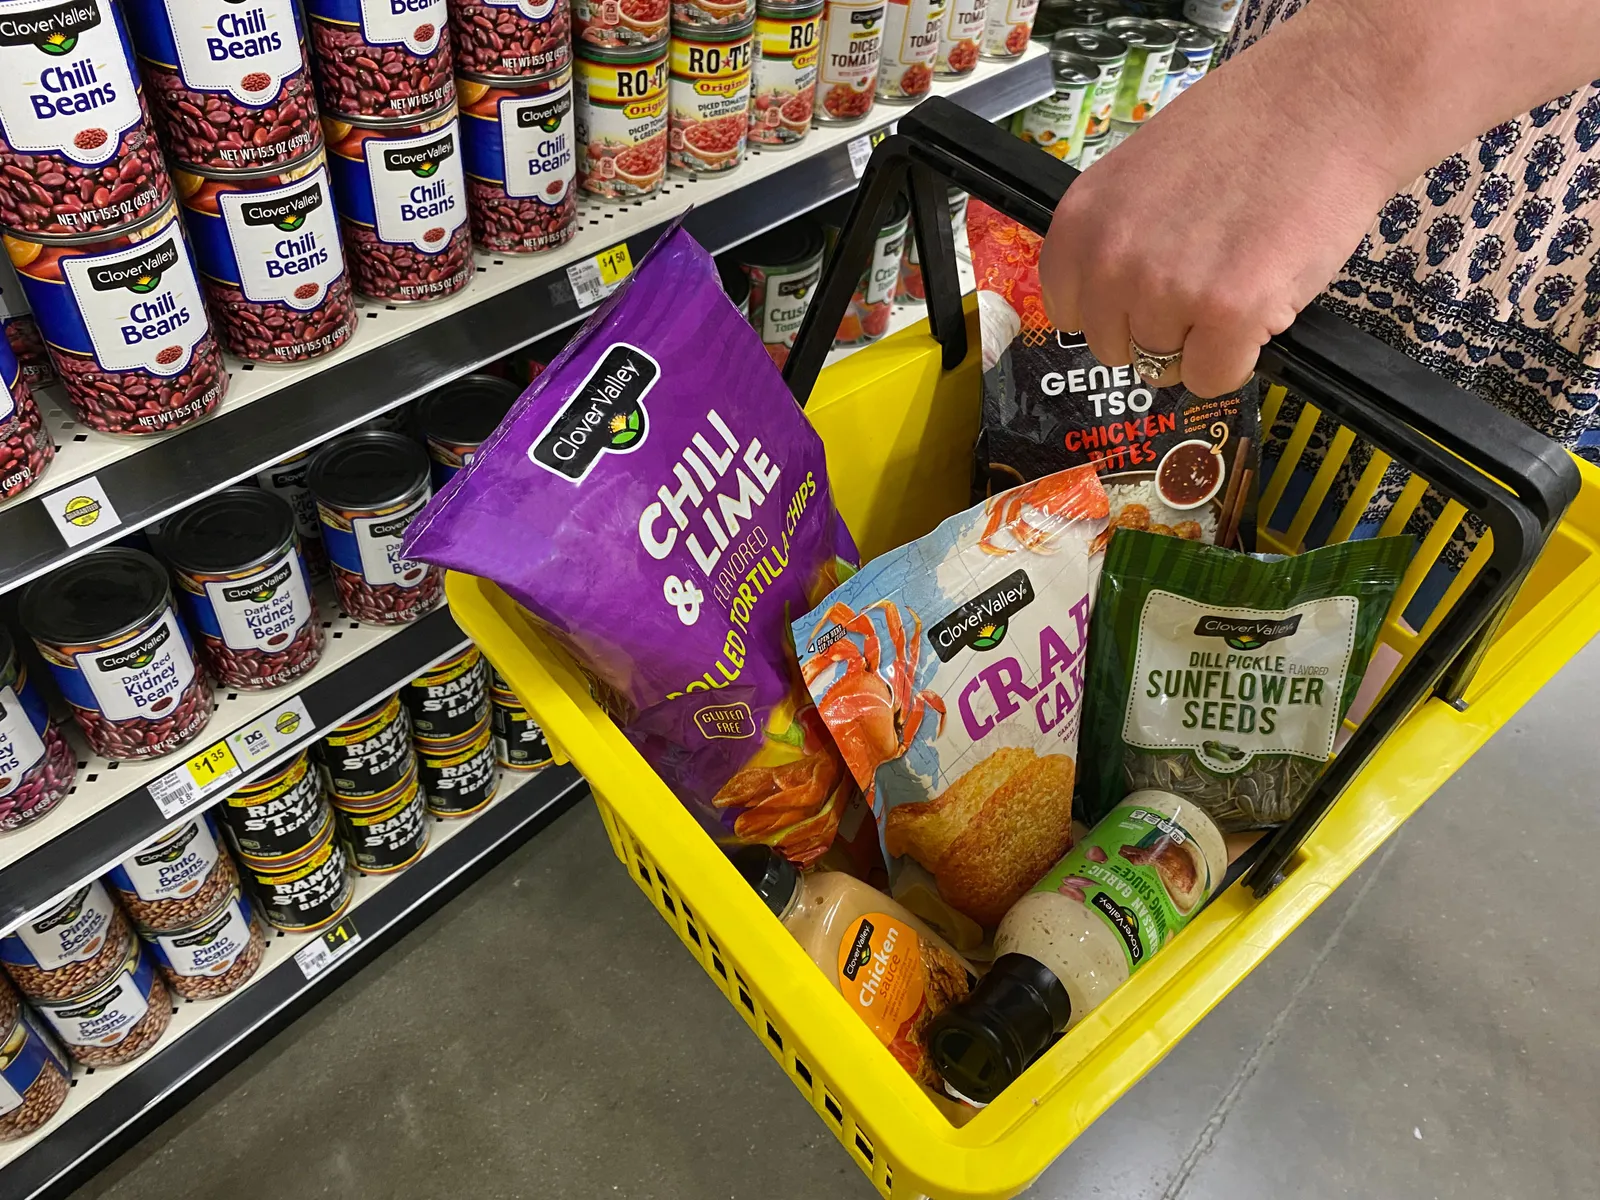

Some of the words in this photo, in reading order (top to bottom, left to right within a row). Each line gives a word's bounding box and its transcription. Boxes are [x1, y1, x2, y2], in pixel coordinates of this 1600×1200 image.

[0, 19, 55, 37] Clover
[54, 6, 92, 28] Valley
[390, 0, 440, 15] Bean
[217, 8, 267, 38] Chili
[789, 23, 814, 50] RO
[206, 31, 282, 61] Beans
[689, 47, 721, 75] RO
[40, 58, 97, 94] Chili
[617, 70, 648, 97] RO
[30, 82, 116, 120] Beans
[522, 107, 553, 122] Clover
[220, 148, 238, 161] NET
[239, 148, 256, 161] WT
[256, 145, 275, 159] 15.5
[275, 140, 288, 154] OZ
[390, 152, 427, 165] Clover
[427, 142, 451, 159] Valley
[537, 133, 565, 158] Chili
[528, 148, 571, 175] Beans
[249, 203, 290, 219] Clover
[289, 191, 318, 212] Valley
[410, 179, 446, 204] Chili
[57, 212, 78, 226] NET
[79, 210, 98, 224] WT
[99, 205, 120, 221] 15.5
[120, 199, 134, 214] OZ
[400, 195, 455, 221] Beans
[275, 232, 317, 259] Chili
[97, 264, 142, 283] Clover
[141, 248, 173, 271] Valley
[266, 248, 328, 279] Beans
[400, 286, 415, 296] NET
[416, 284, 428, 294] WT
[429, 281, 443, 293] 15.5
[443, 277, 453, 289] OZ
[130, 291, 176, 323] Chili
[121, 307, 190, 345] Beans
[274, 346, 290, 356] NET
[291, 344, 305, 355] WT
[306, 340, 321, 352] 15.5
[321, 335, 333, 347] OZ
[139, 416, 158, 427] NET
[158, 411, 174, 424] WT
[174, 405, 191, 420] 15.5
[191, 399, 202, 412] OZ
[552, 403, 605, 463] Clover
[597, 358, 641, 406] Valley
[1088, 388, 1153, 418] TSO
[1183, 405, 1200, 416] with
[1202, 402, 1218, 410] rice
[1190, 409, 1222, 423] General
[1223, 408, 1238, 416] Tso
[1065, 412, 1176, 452] CHICKEN
[1088, 440, 1157, 472] BITES
[639, 409, 740, 560] CHILI
[374, 519, 405, 534] Clover
[663, 575, 703, 626] &
[685, 437, 781, 577] LIME
[713, 525, 769, 610] FLAVORED
[229, 584, 264, 598] Clover
[263, 568, 288, 587] Valley
[665, 629, 746, 700] OLLED
[729, 531, 790, 634] TORTILLA
[785, 471, 816, 537] CHIPS
[244, 604, 270, 617] Dark
[272, 590, 290, 607] Red
[246, 599, 294, 629] Kidney
[938, 609, 984, 649] Clover
[980, 583, 1023, 618] Valley
[253, 614, 296, 640] Beans
[1205, 620, 1254, 633] Clover
[1256, 622, 1291, 636] Valley
[102, 648, 141, 668] Clover
[140, 630, 168, 652] Valley
[1189, 651, 1223, 669] DILL
[1224, 653, 1287, 673] PICKLE
[1288, 663, 1330, 676] FLAVORED
[121, 668, 150, 685] Dark
[151, 652, 171, 671] Red
[125, 662, 175, 697] Kidney
[133, 676, 179, 708] Beans
[1146, 669, 1325, 706] SUNFLOWER
[702, 709, 744, 723] GLUTEN
[716, 721, 741, 735] FREE
[1182, 701, 1278, 735] SEEDS
[136, 745, 151, 755] NET
[151, 740, 165, 751] WT
[180, 728, 190, 738] OZ
[244, 730, 264, 746] DG
[141, 848, 172, 863] Clover
[158, 852, 197, 878] Pinto
[154, 877, 189, 895] Frijoles
[159, 857, 203, 888] Beans
[1088, 865, 1133, 899] GARLIC
[1120, 867, 1155, 901] SAUCE
[59, 908, 94, 941] Pinto
[1100, 897, 1124, 927] Valley
[1149, 896, 1166, 935] WING
[60, 912, 101, 951] Beans
[327, 926, 349, 942] $1
[1121, 923, 1140, 958] Clover
[193, 936, 228, 959] Pinto
[193, 941, 235, 967] Beans
[846, 947, 861, 975] Clover
[856, 925, 871, 949] Valley
[859, 927, 899, 1007] Chicken
[880, 954, 901, 999] sauce
[79, 1009, 119, 1030] Pinto
[80, 1014, 127, 1038] Beans
